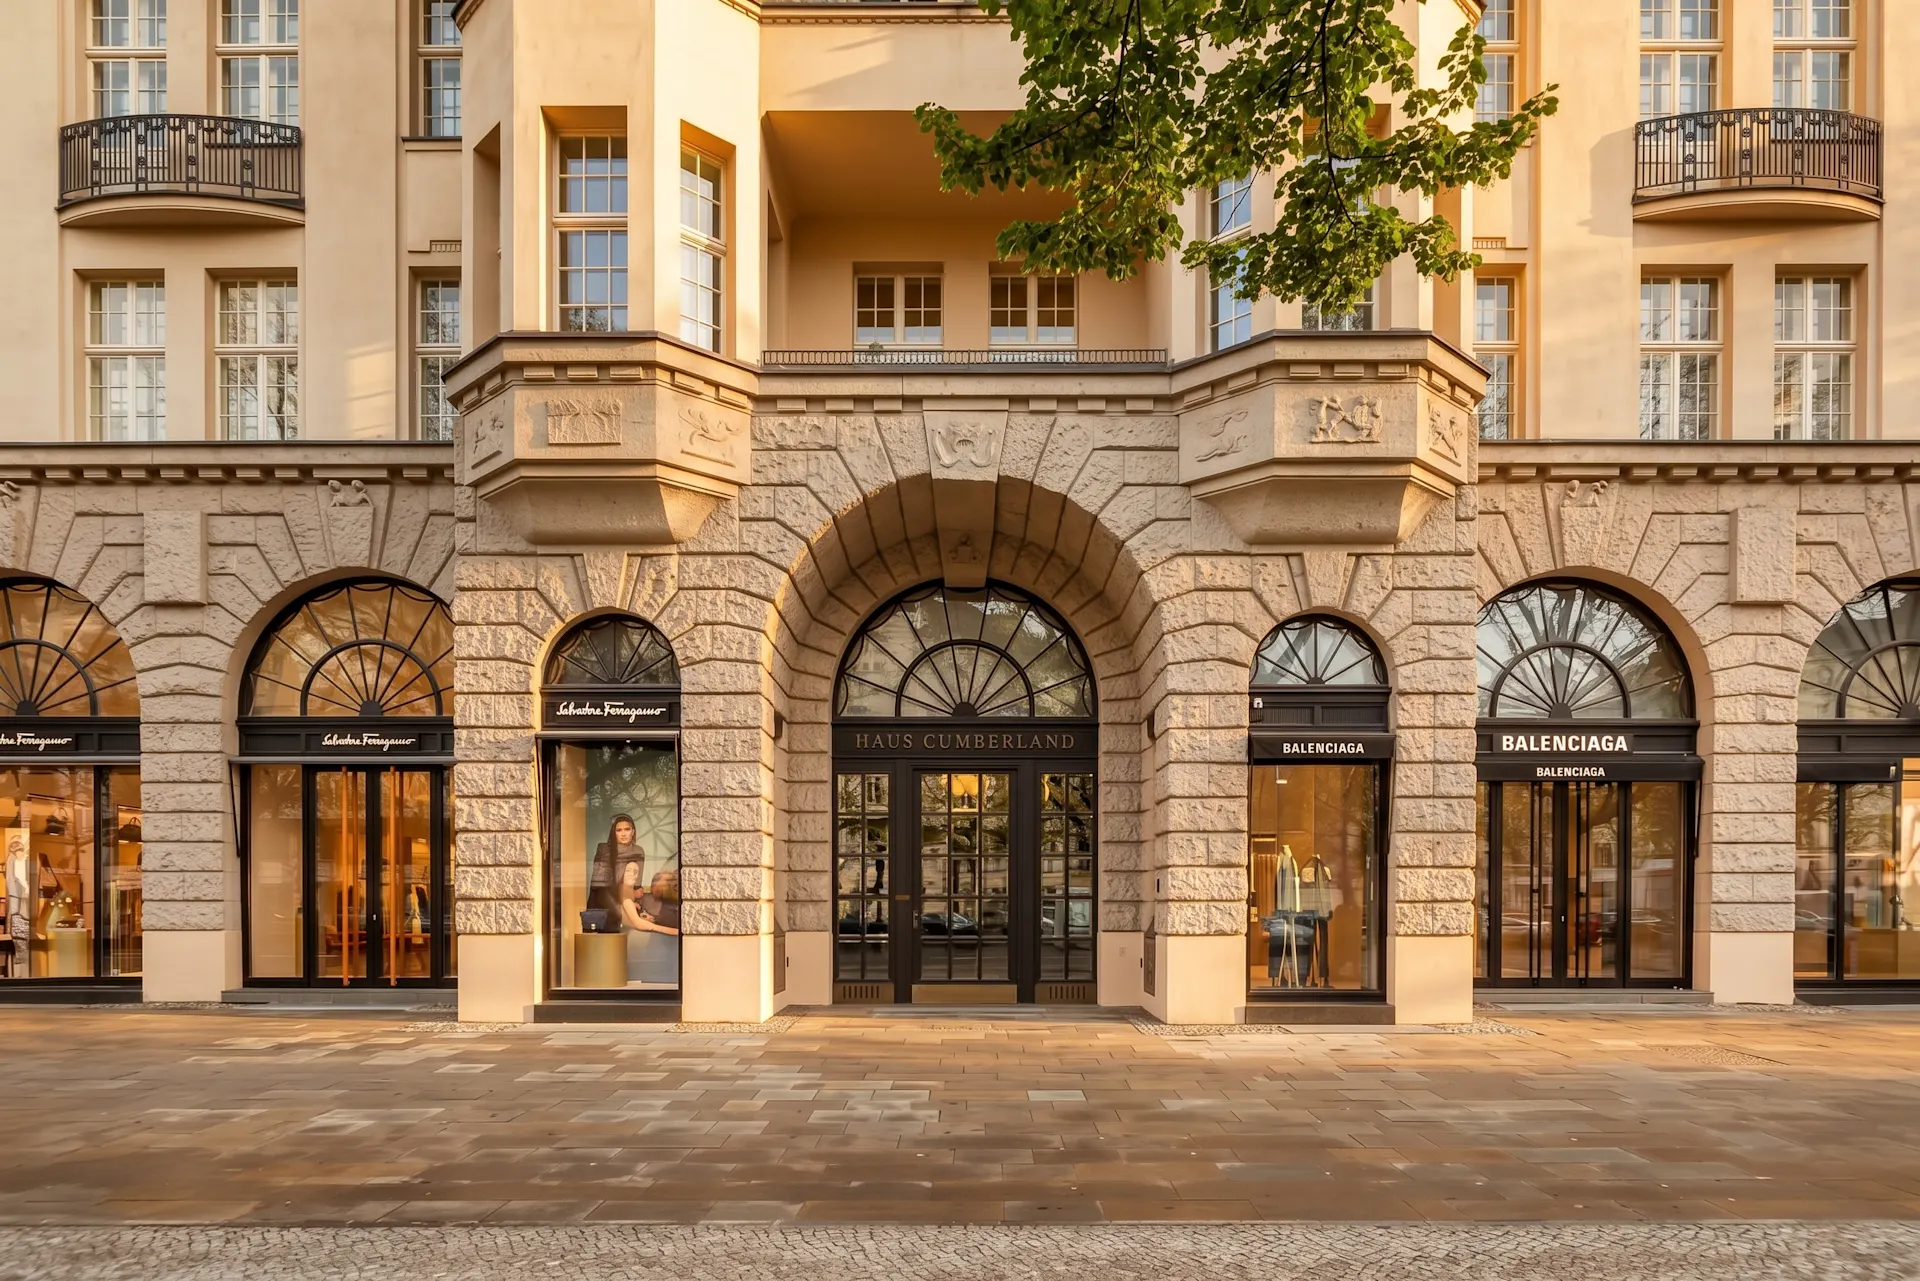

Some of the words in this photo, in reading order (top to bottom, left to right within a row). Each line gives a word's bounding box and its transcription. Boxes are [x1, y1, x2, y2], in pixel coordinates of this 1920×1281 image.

[556, 702, 604, 716] Salvatore
[604, 701, 667, 724] Ferragamo
[16, 732, 73, 752] Ferragamo
[322, 734, 362, 746] Salvatore
[362, 733, 416, 752] Ferragamo
[855, 734, 914, 749] HAUS
[923, 734, 1075, 749] CUMBERLAND
[1282, 742, 1365, 754] BALENCIAGA
[1502, 735, 1628, 751] BALENCIAGA
[1536, 767, 1606, 777] BALENCIAGA
